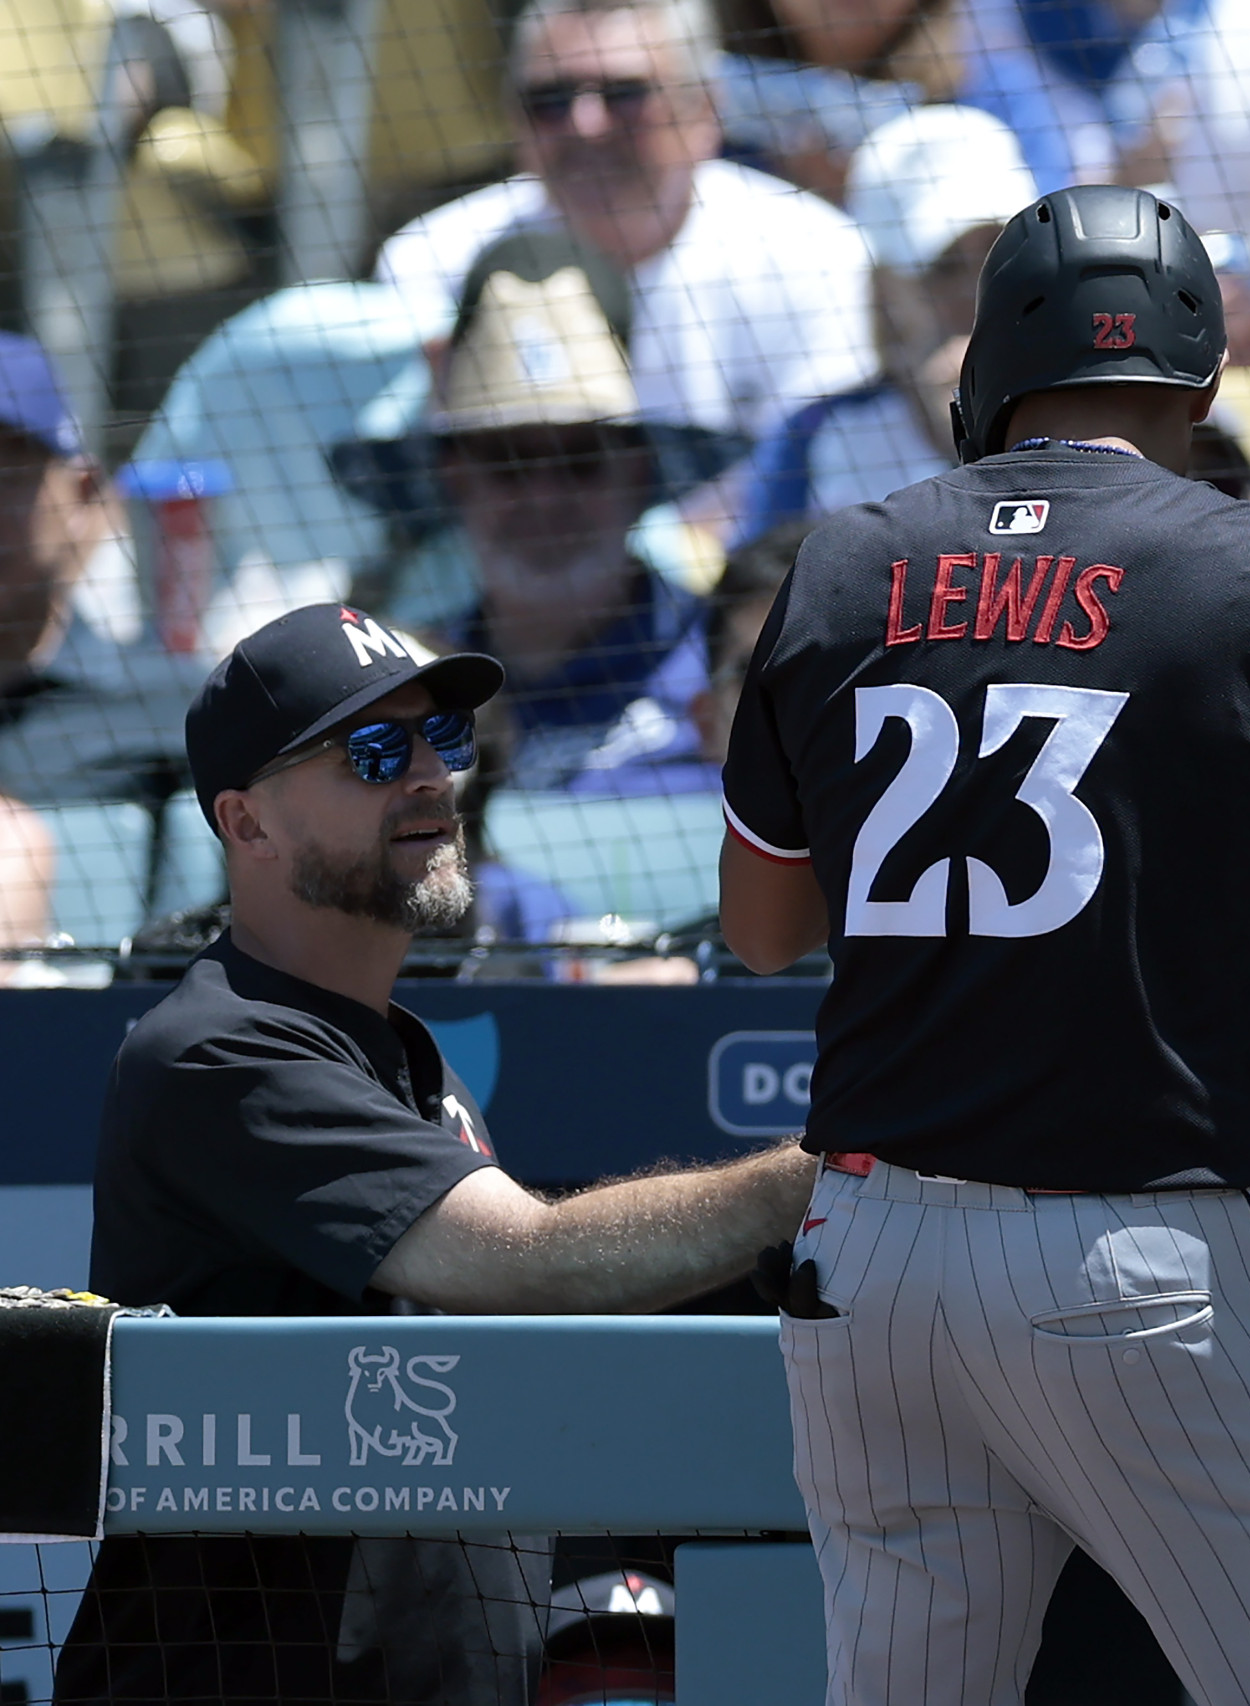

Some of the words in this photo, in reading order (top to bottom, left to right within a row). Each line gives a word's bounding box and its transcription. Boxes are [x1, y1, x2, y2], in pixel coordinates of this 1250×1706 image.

[1093, 312, 1136, 349] 23
[886, 552, 1125, 651] LEWIS
[341, 617, 408, 668] M
[843, 683, 1131, 938] 23
[743, 1062, 812, 1106] DO
[106, 1487, 147, 1513] OF
[155, 1486, 322, 1514] AMERICA
[331, 1486, 512, 1514] COMPANY
